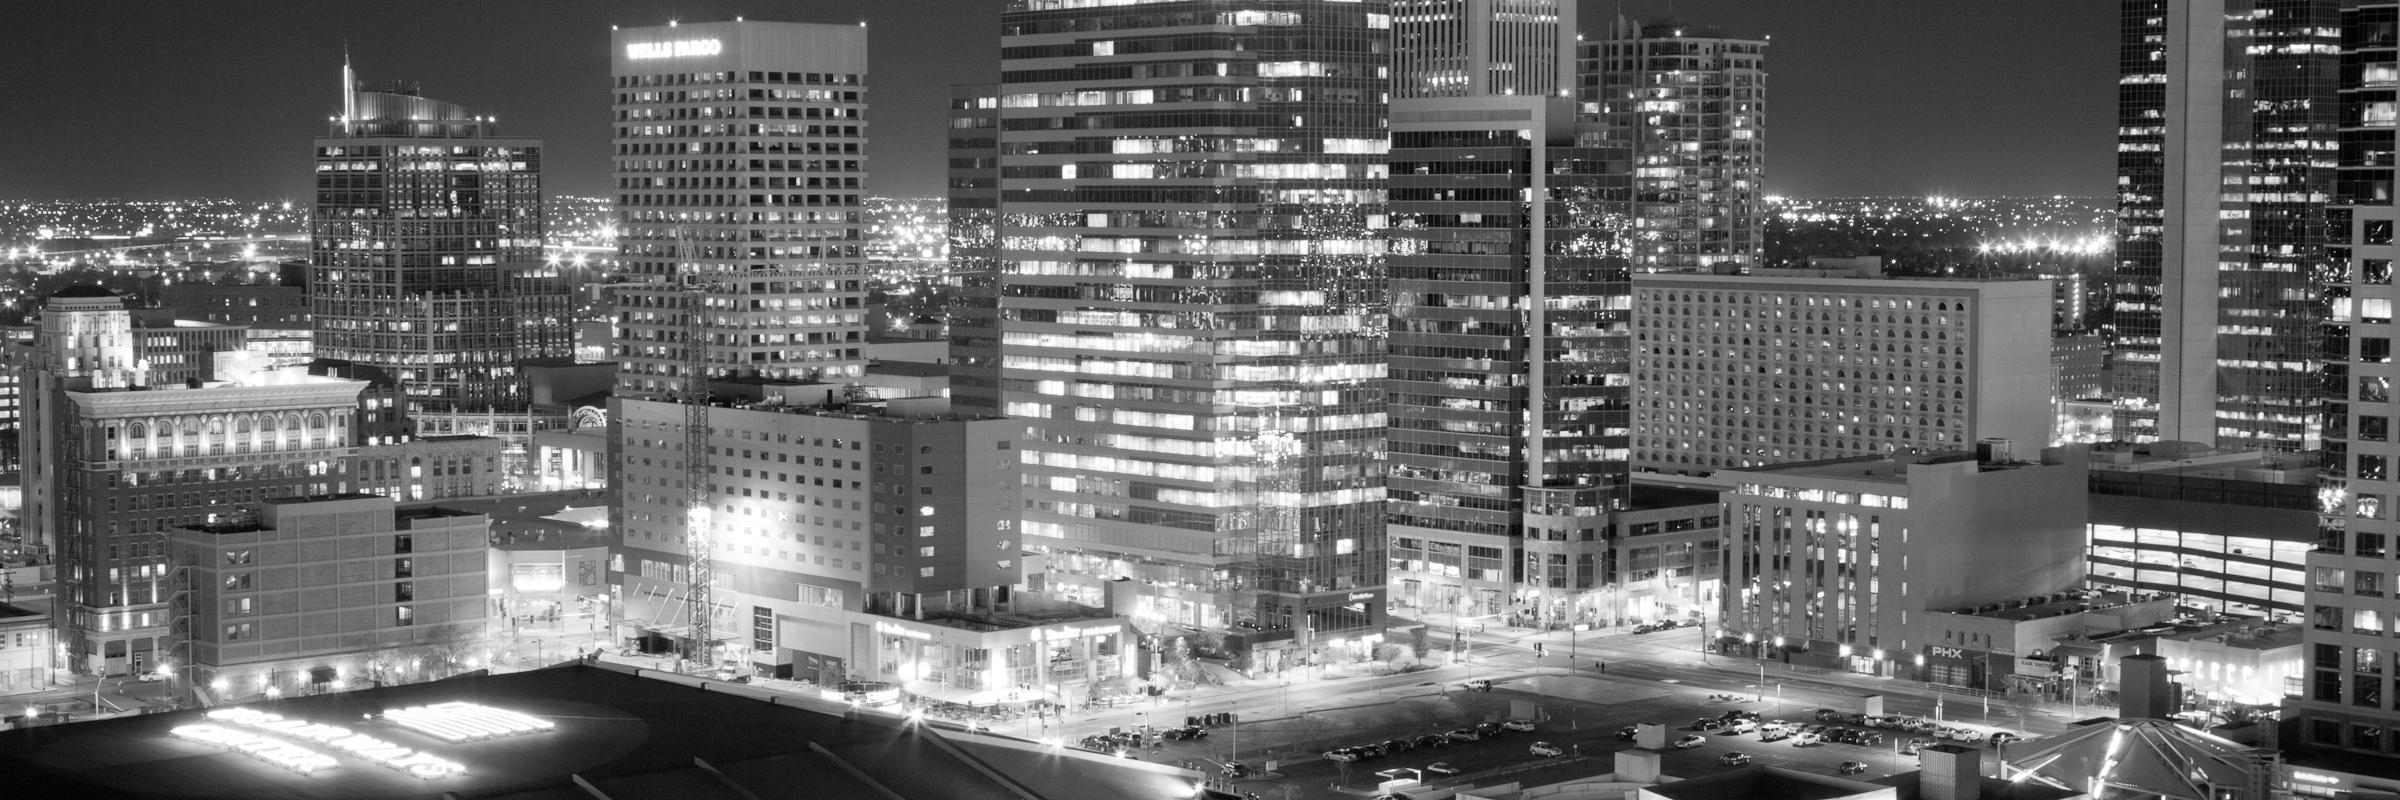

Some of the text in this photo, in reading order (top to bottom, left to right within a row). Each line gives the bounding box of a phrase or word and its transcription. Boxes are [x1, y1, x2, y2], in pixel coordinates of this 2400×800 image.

[626, 38, 722, 60] WELLS FARGO
[1932, 646, 1963, 660] PHX
